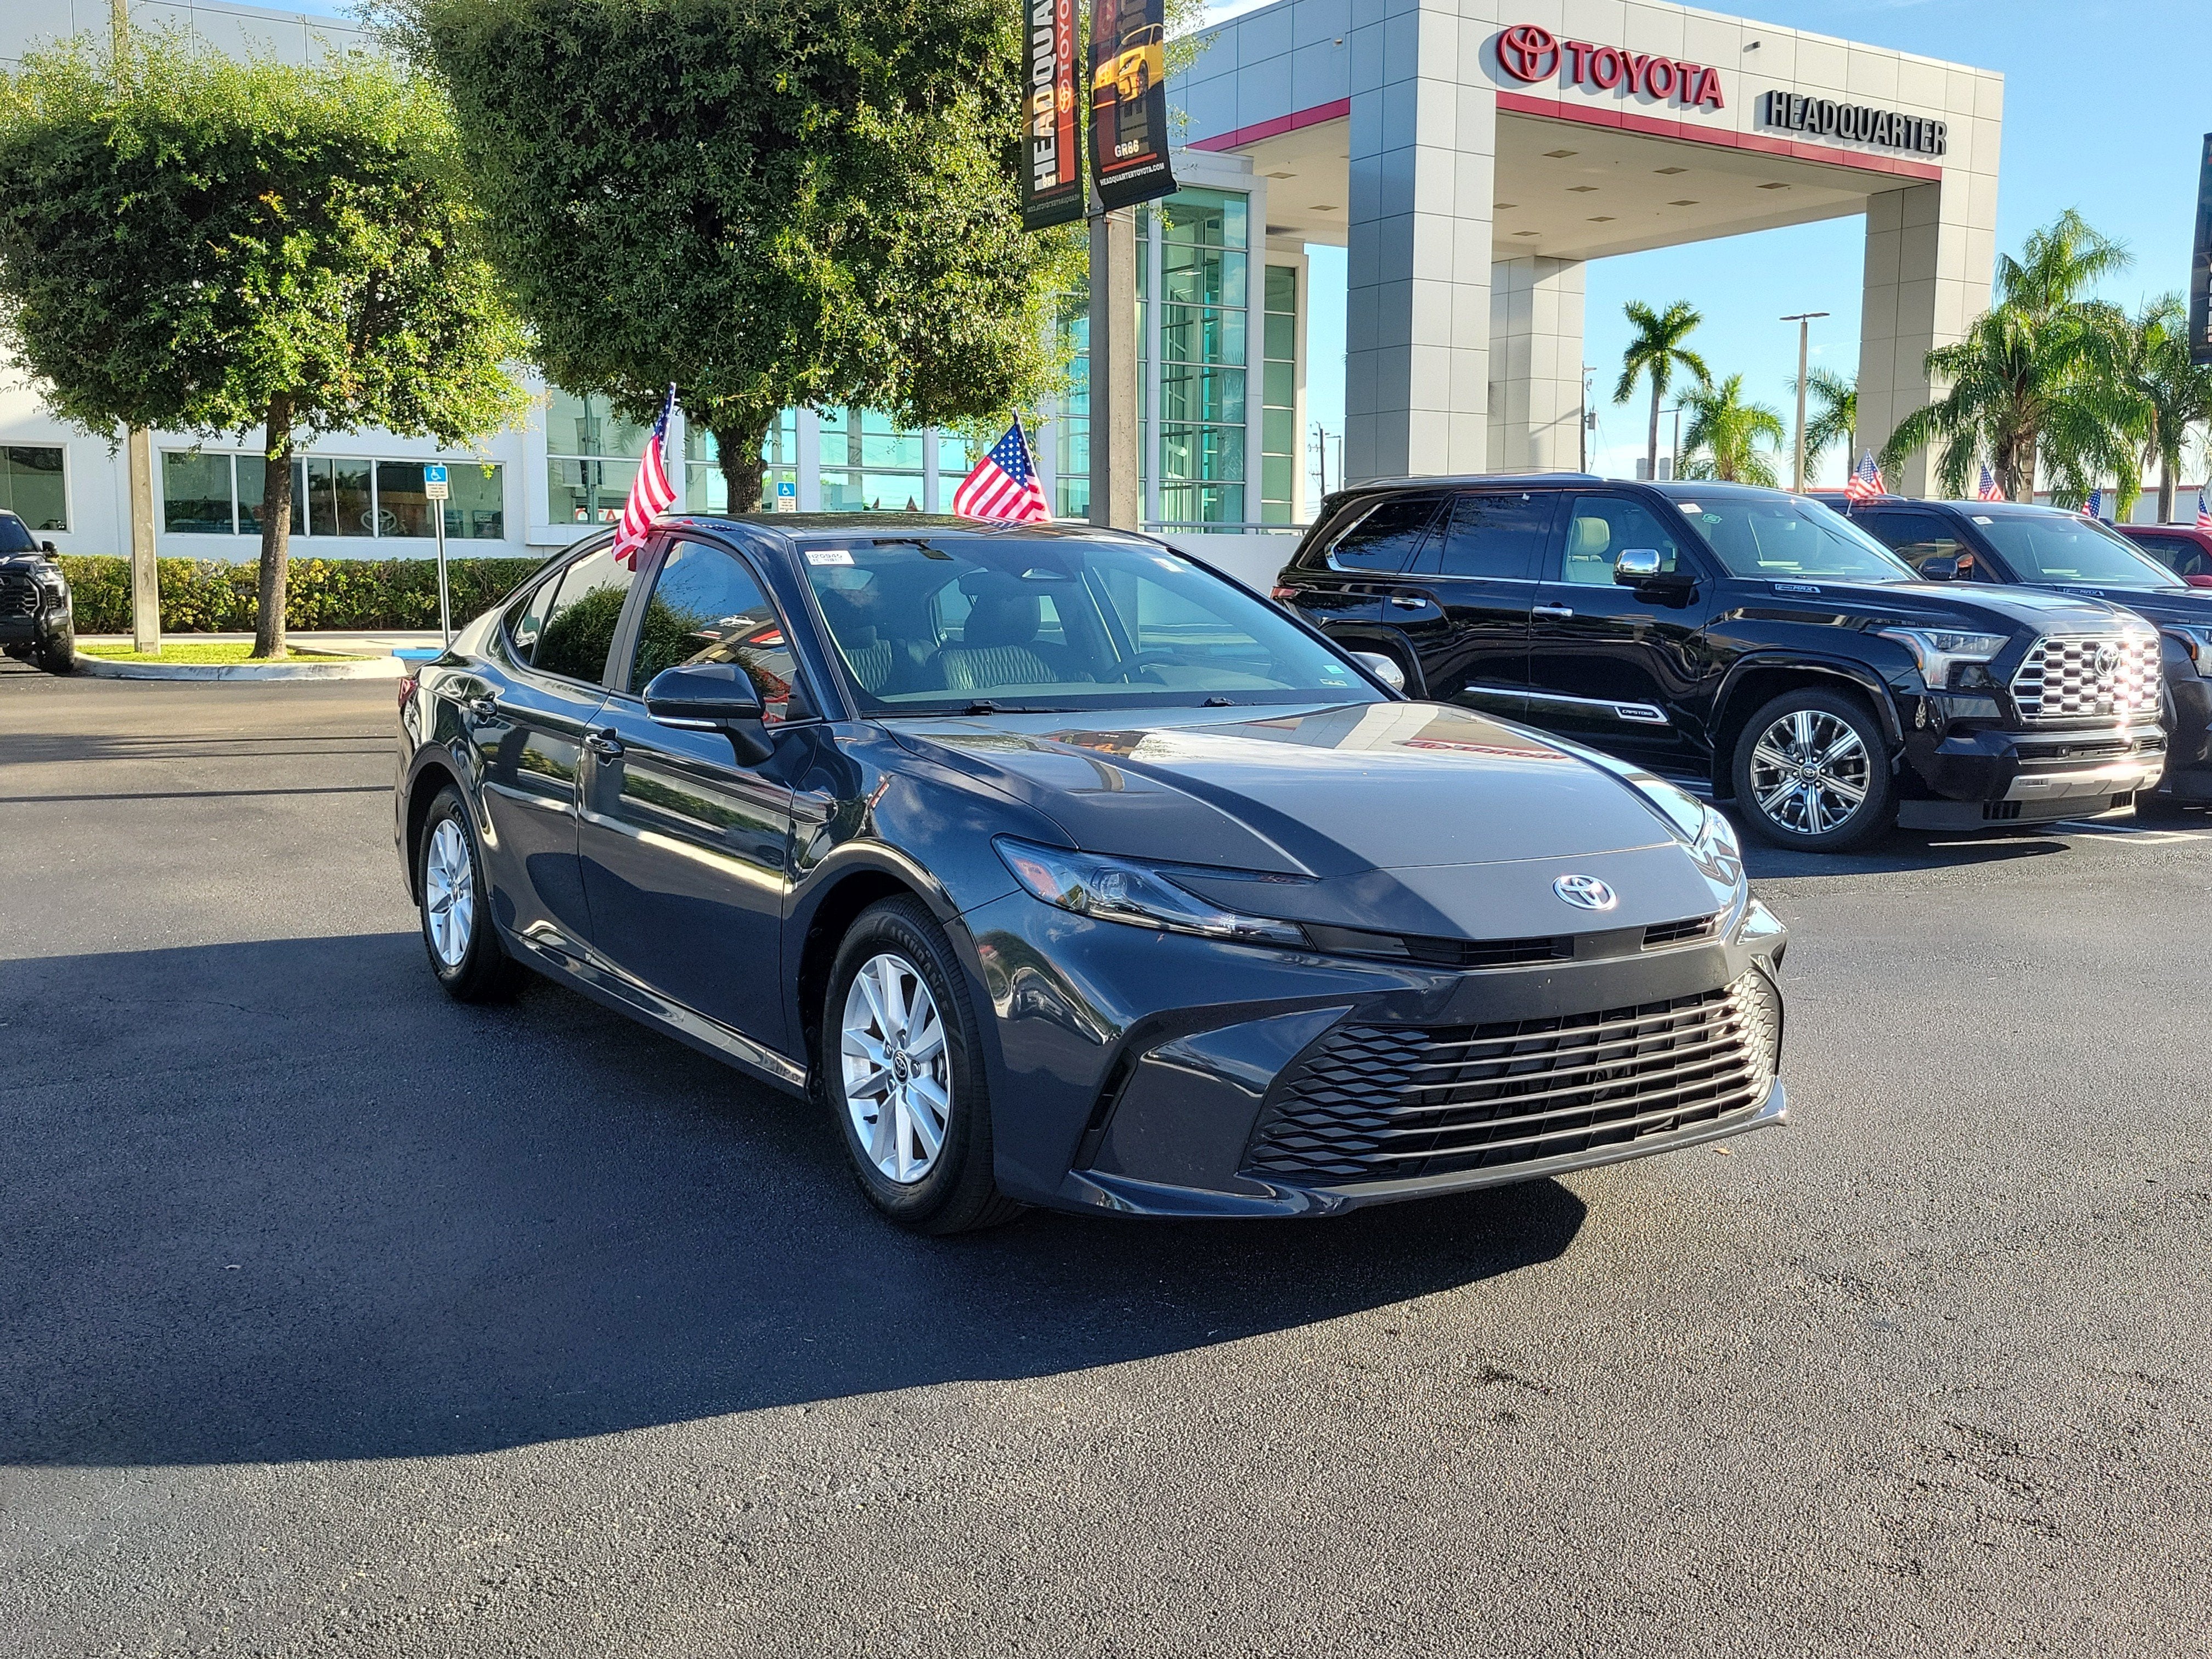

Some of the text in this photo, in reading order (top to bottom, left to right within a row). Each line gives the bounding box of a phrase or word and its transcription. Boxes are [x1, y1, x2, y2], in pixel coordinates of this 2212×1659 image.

[1032, 0, 1057, 191] HEADQUA
[1565, 41, 1724, 108] TOYOTA
[1114, 139, 1139, 157] GR86
[1767, 90, 1947, 155] HEADQUARTER
[1099, 162, 1165, 186] HEADQUARTERTOYOTA.COM
